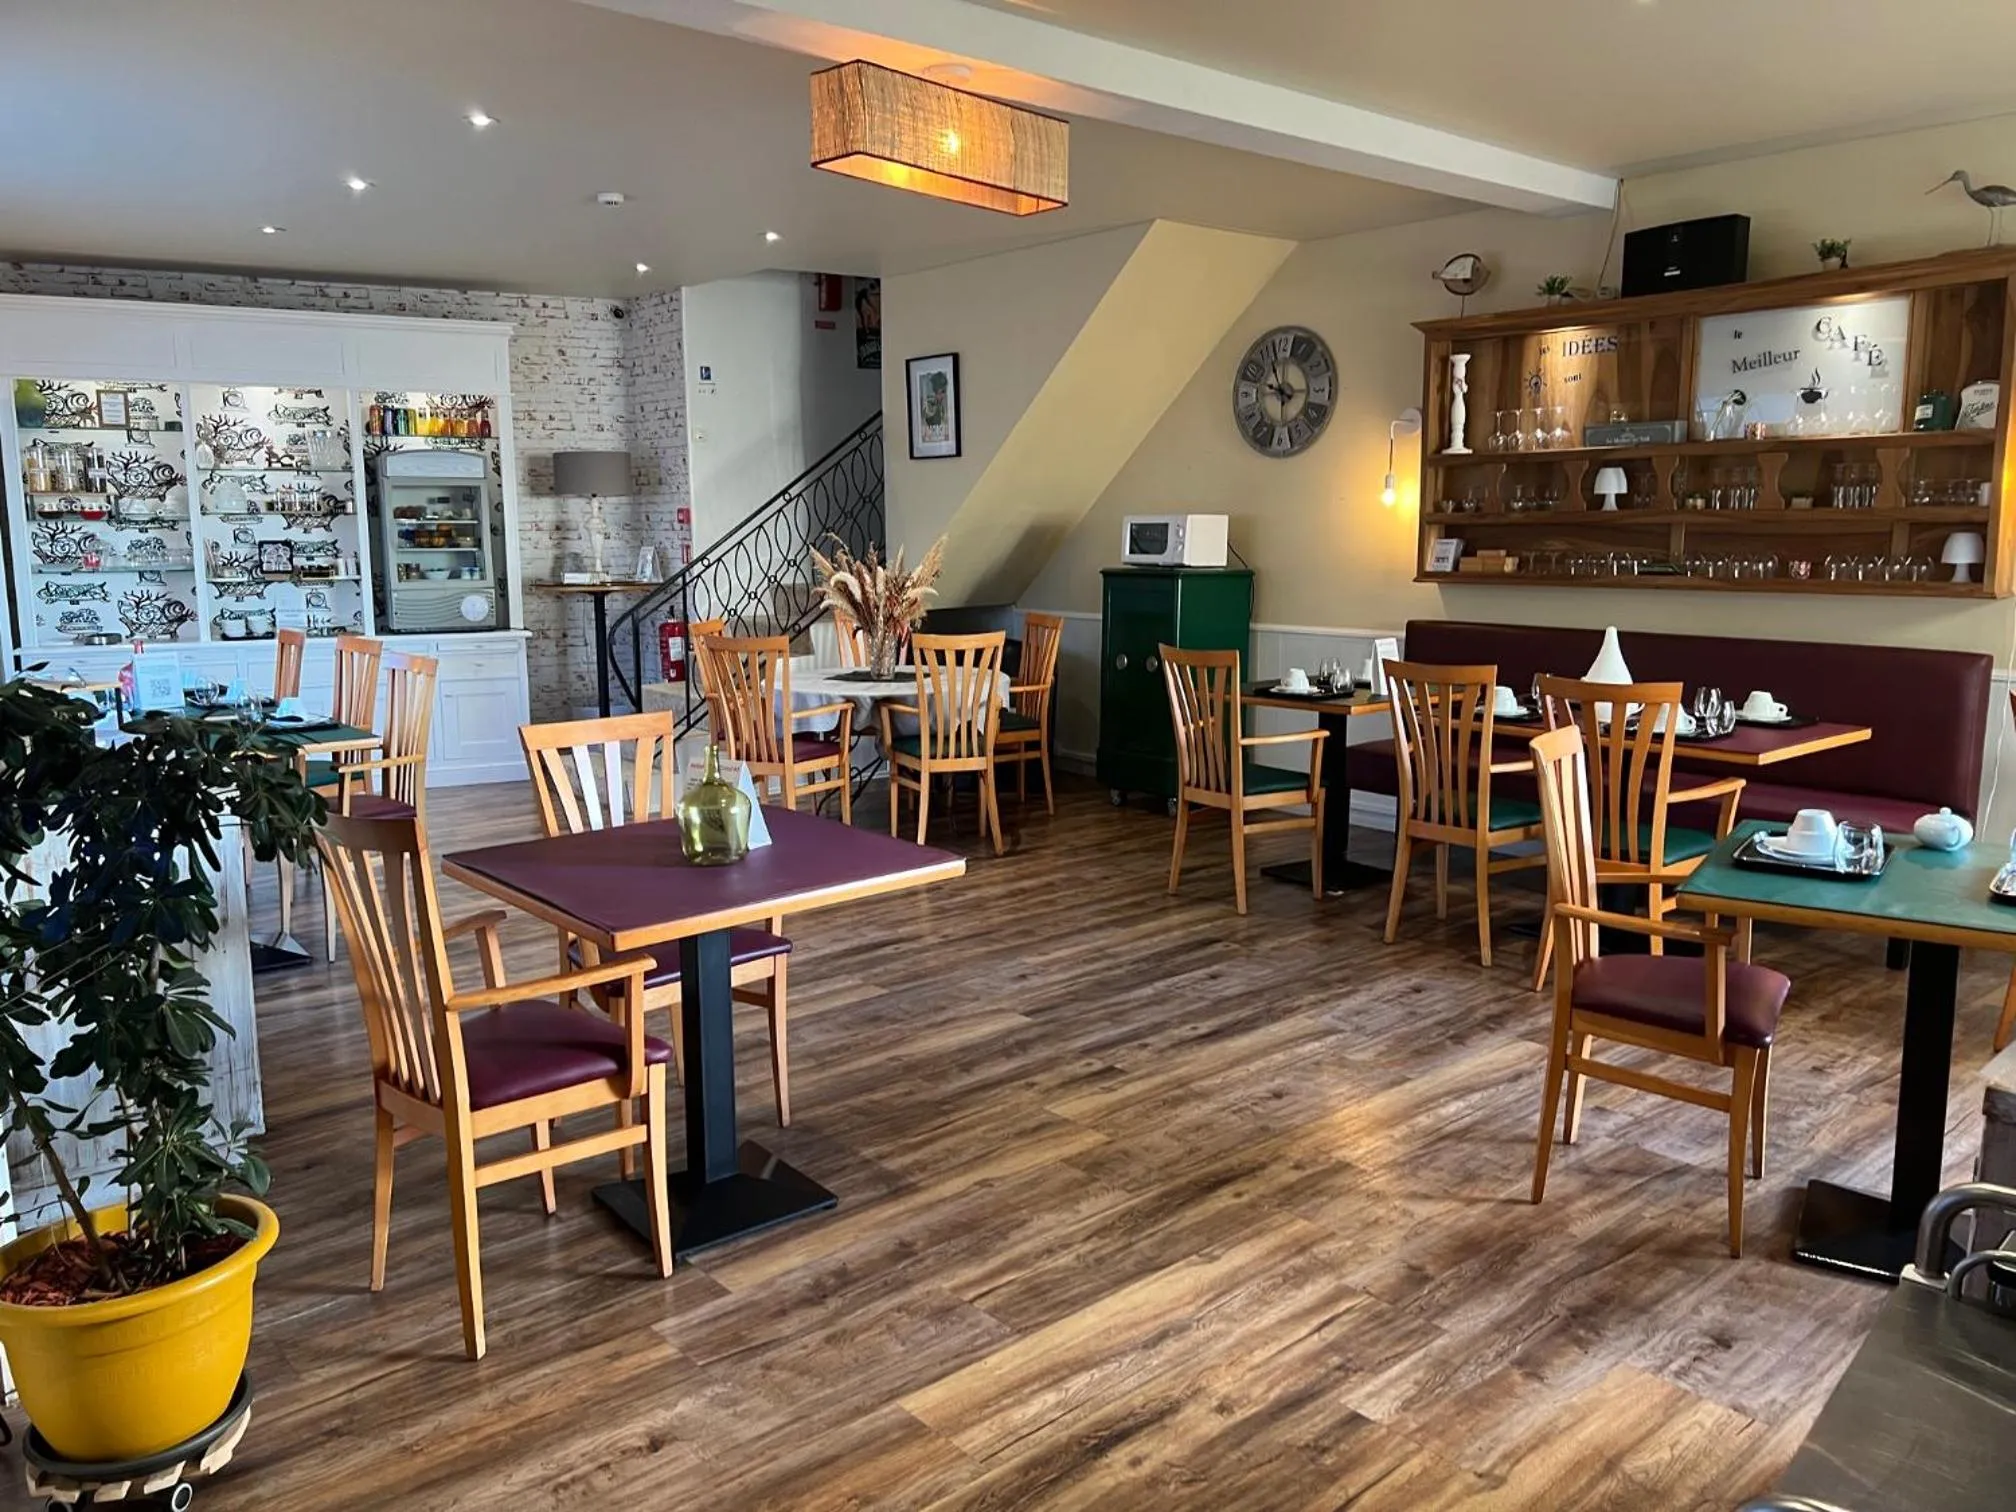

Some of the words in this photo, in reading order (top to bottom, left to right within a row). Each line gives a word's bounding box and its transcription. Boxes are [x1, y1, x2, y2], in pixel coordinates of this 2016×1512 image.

[1562, 334, 1618, 357] IDÉES
[1733, 329, 1743, 339] le
[1816, 316, 1884, 366] CAFÉ
[1732, 350, 1801, 374] Meilleur
